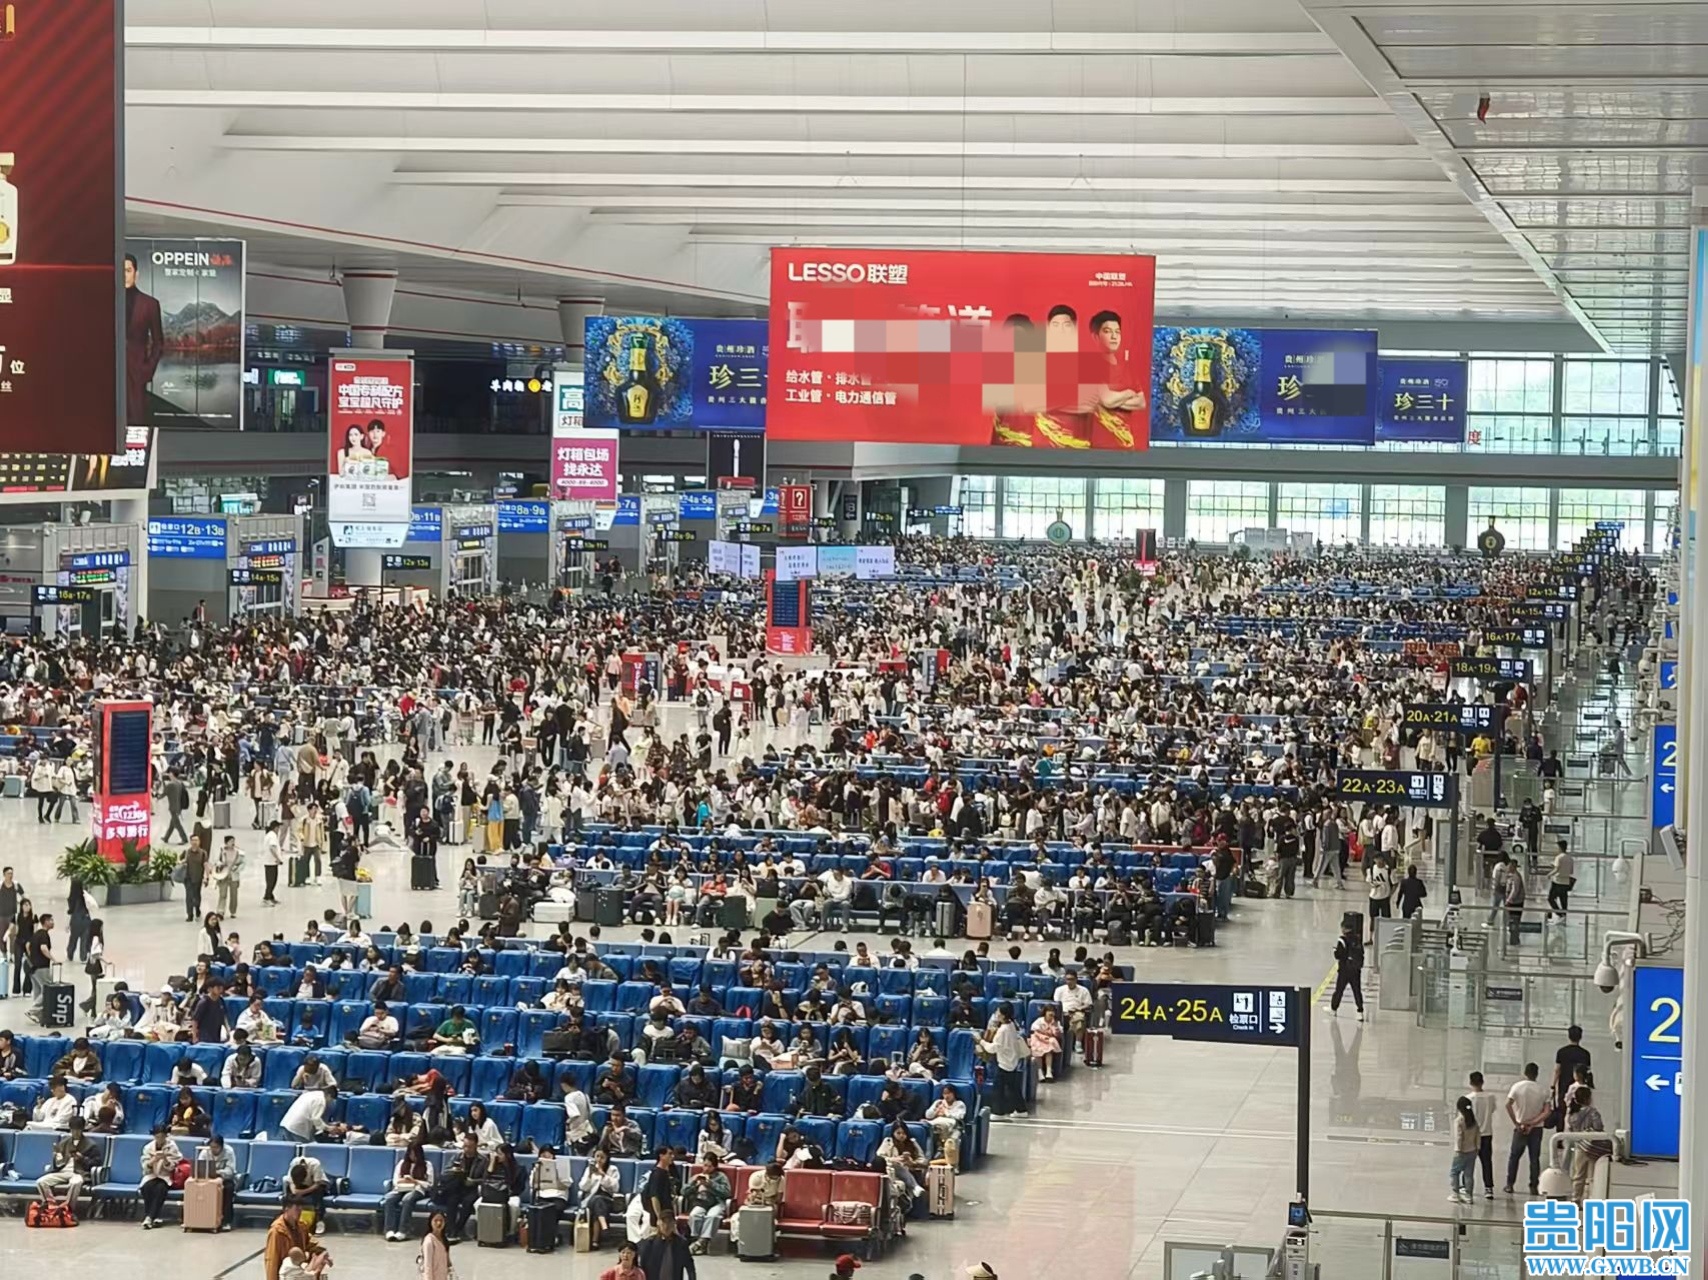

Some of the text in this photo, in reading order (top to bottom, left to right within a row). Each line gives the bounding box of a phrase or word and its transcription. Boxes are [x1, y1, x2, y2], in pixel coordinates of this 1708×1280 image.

[152, 252, 209, 266] OPPEIN
[788, 262, 908, 284] LESSO 联塑
[709, 363, 768, 390] 珍三
[561, 387, 584, 410] 高
[1394, 391, 1454, 411] 珍三十
[557, 447, 610, 461] 灯箱包场
[563, 463, 604, 477] 找永达
[1511, 607, 1544, 616] 14A·15A
[1486, 631, 1522, 642] 16A·17A
[1455, 661, 1498, 674] 18A·19A
[1407, 709, 1458, 723] 20A·21A
[1341, 777, 1406, 794] 22A·23A
[1120, 997, 1223, 1022] 24A·25A
[1229, 1013, 1258, 1025] 检票口
